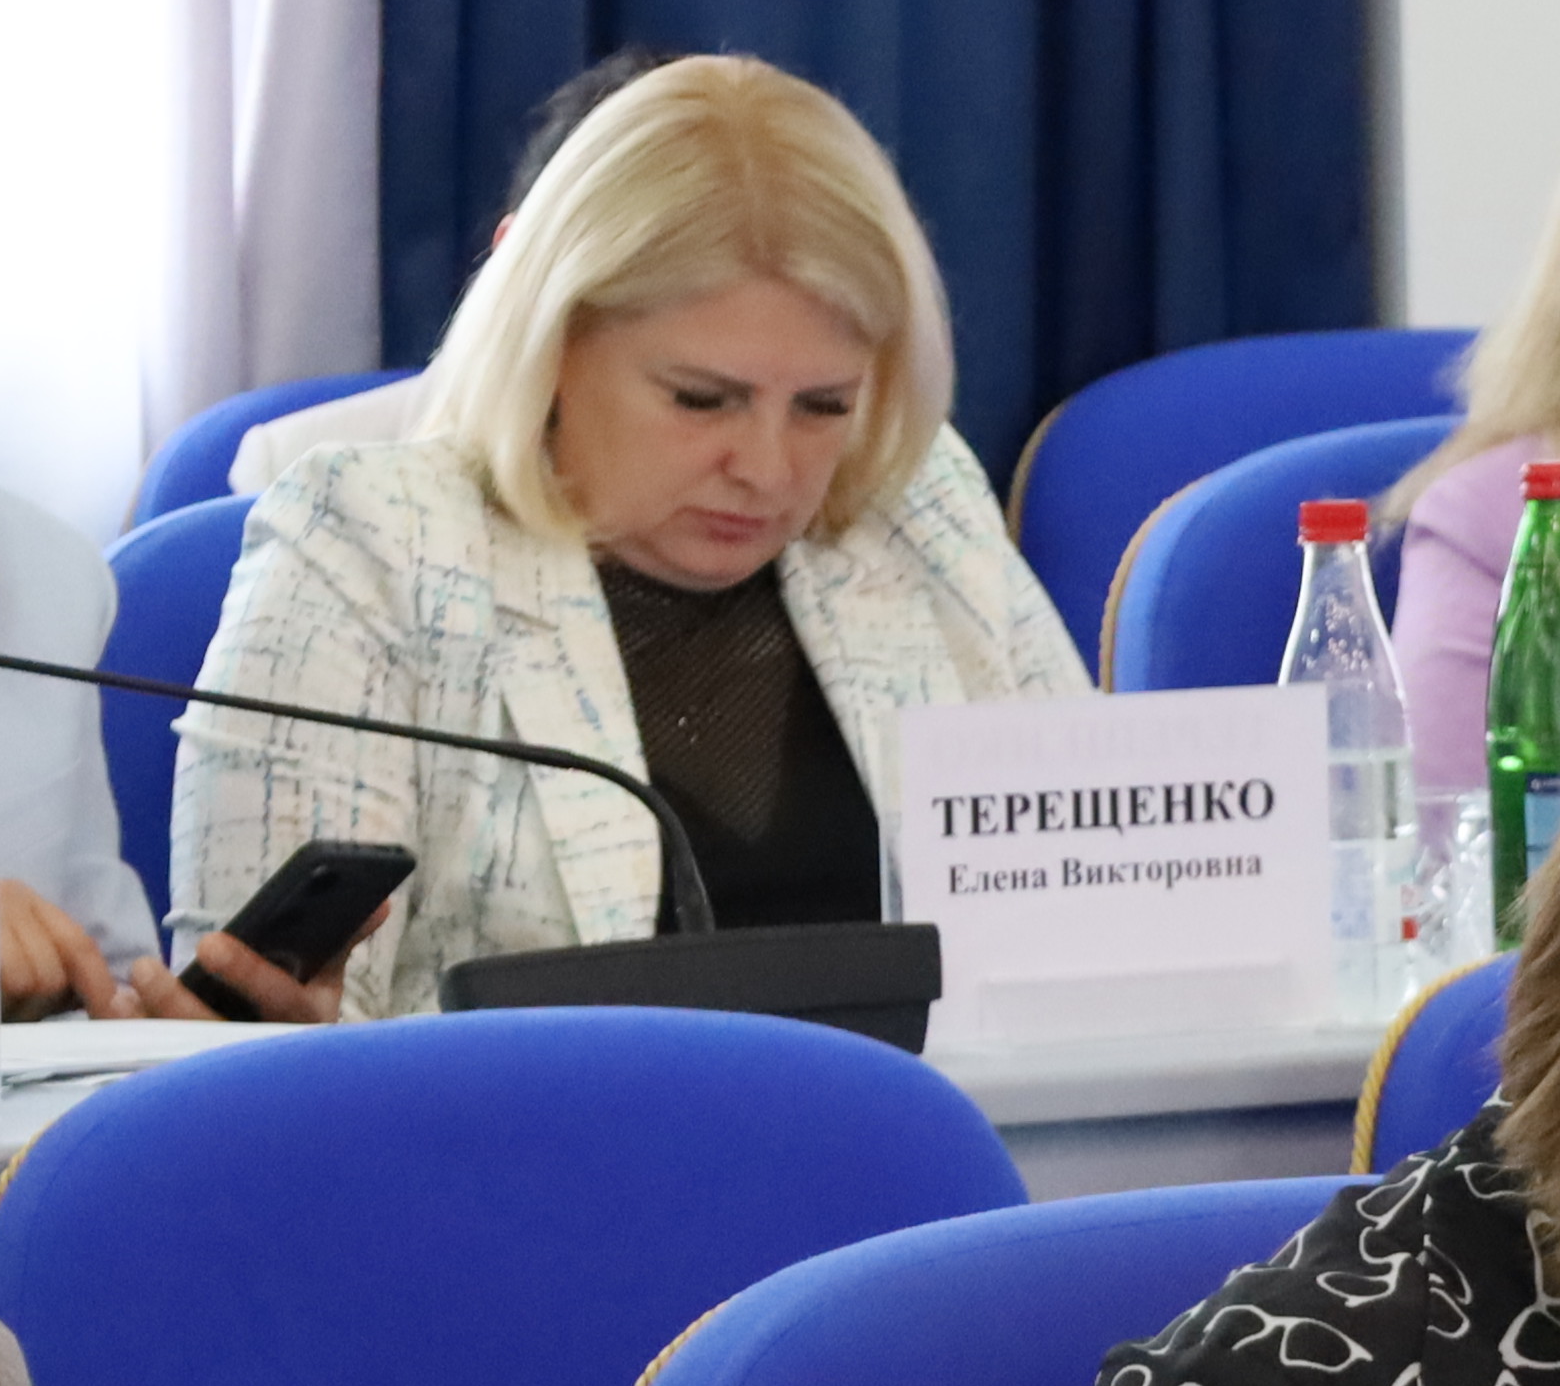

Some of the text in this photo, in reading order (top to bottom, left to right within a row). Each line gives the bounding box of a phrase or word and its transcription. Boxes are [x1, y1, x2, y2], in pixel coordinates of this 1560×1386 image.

[931, 777, 1276, 839] ТЕРЕЩЕНКО
[948, 853, 1263, 896] Елена Викторовна
